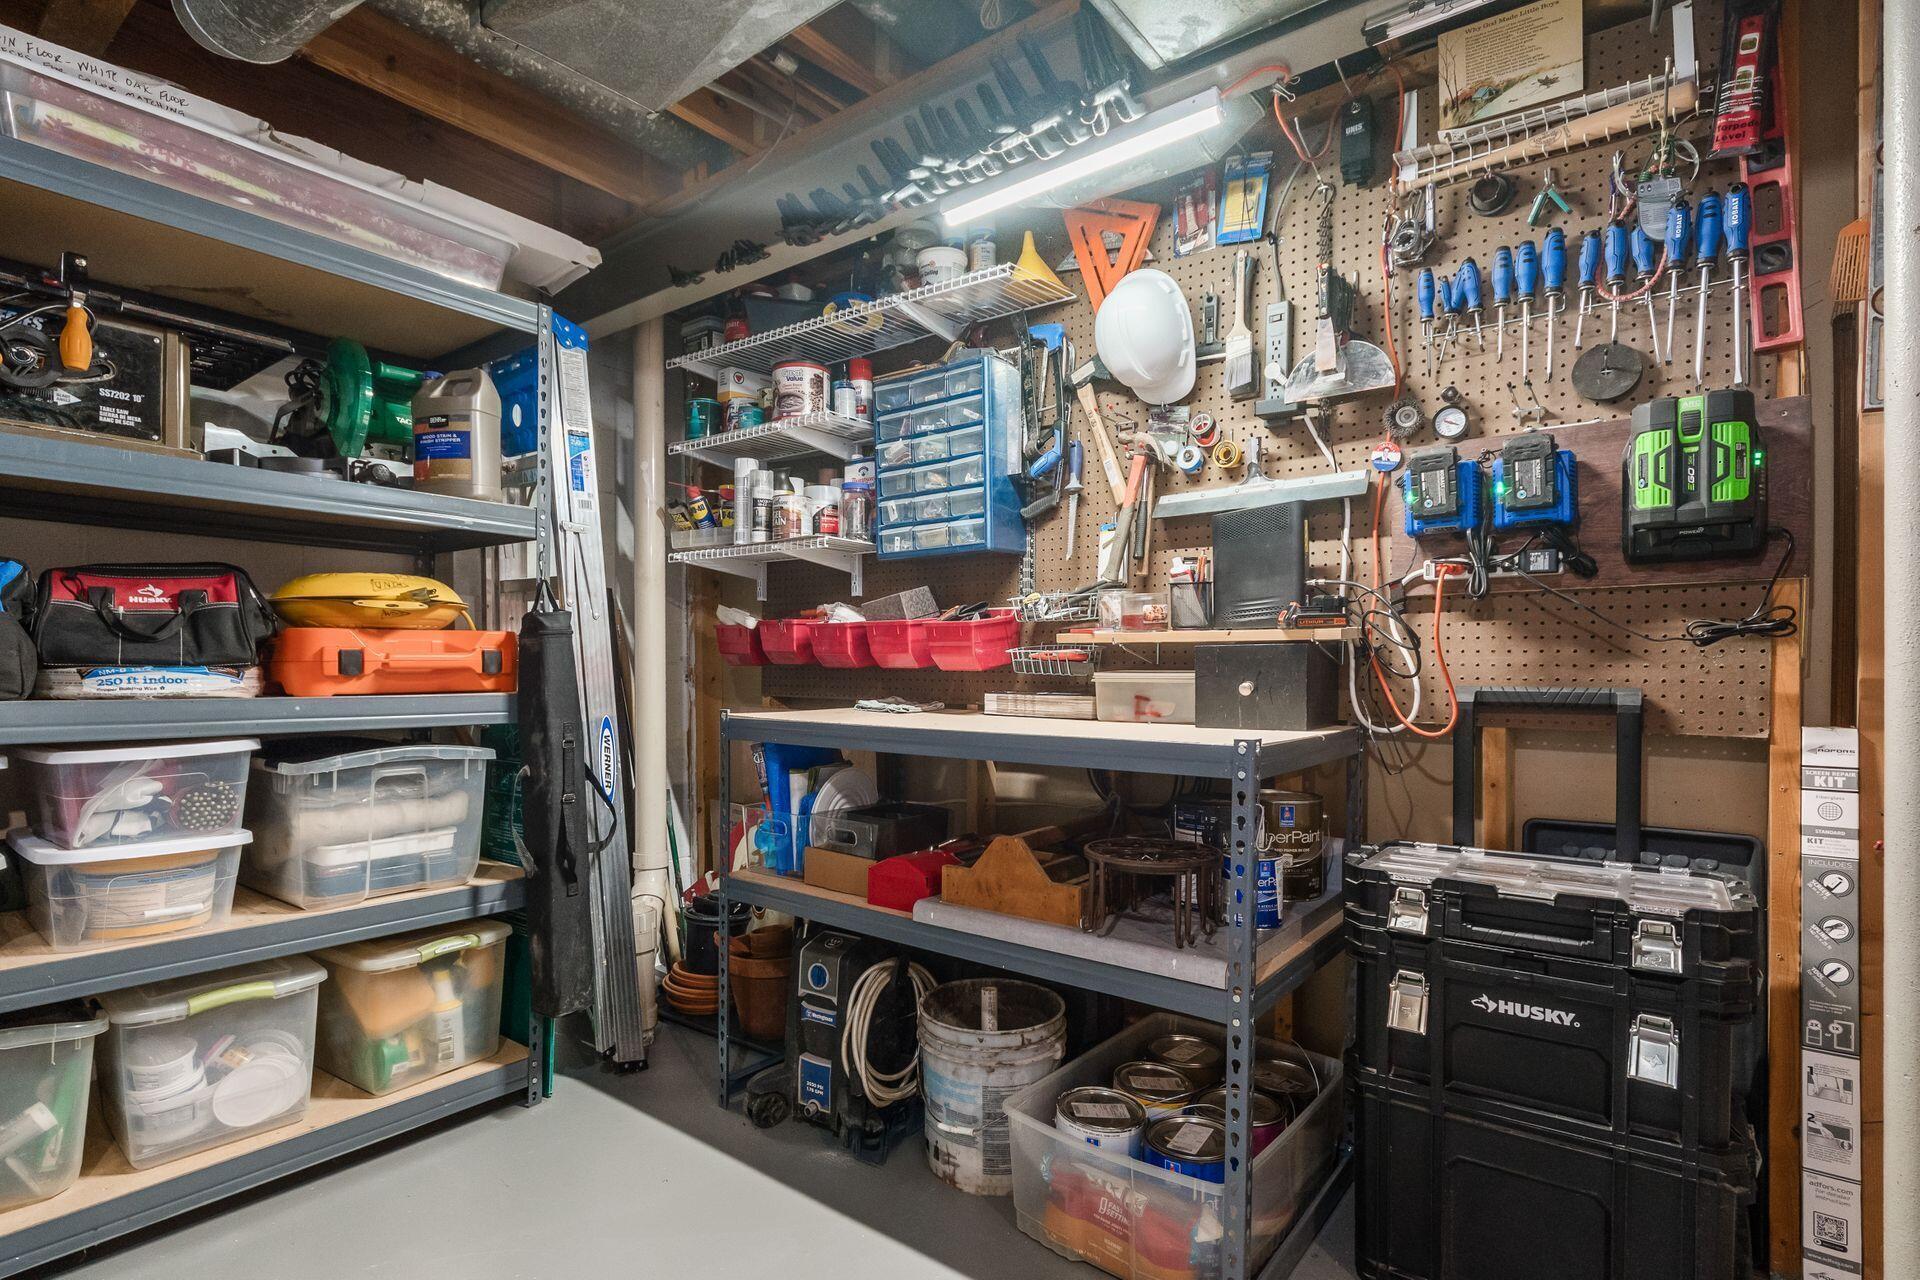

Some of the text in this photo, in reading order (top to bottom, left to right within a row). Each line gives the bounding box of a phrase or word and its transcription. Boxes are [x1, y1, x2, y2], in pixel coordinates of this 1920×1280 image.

[0, 35, 16, 48] IN
[77, 61, 118, 83] WHITE
[125, 77, 151, 95] OAK
[159, 90, 190, 107] FLOOR
[1731, 197, 1739, 225] KOBALT
[1675, 214, 1683, 239] KOBALT
[785, 374, 804, 382] Value
[99, 387, 130, 402] SS7202
[1687, 467, 1695, 491] EGO
[128, 595, 172, 604] HUSKY
[96, 675, 189, 687] 250 ft indoor
[603, 734, 612, 789] WERNER
[1814, 775, 1847, 789] KIT
[1265, 829, 1321, 846] perPaint
[1814, 828, 1846, 836] STANDARD
[1806, 837, 1824, 845] KIT
[1808, 858, 1853, 869] INCLUDES
[1498, 999, 1577, 1027] HUSKY
[1807, 1065, 1814, 1076] 1
[1807, 1112, 1815, 1123] 2
[1808, 1180, 1854, 1196] adfors.com
